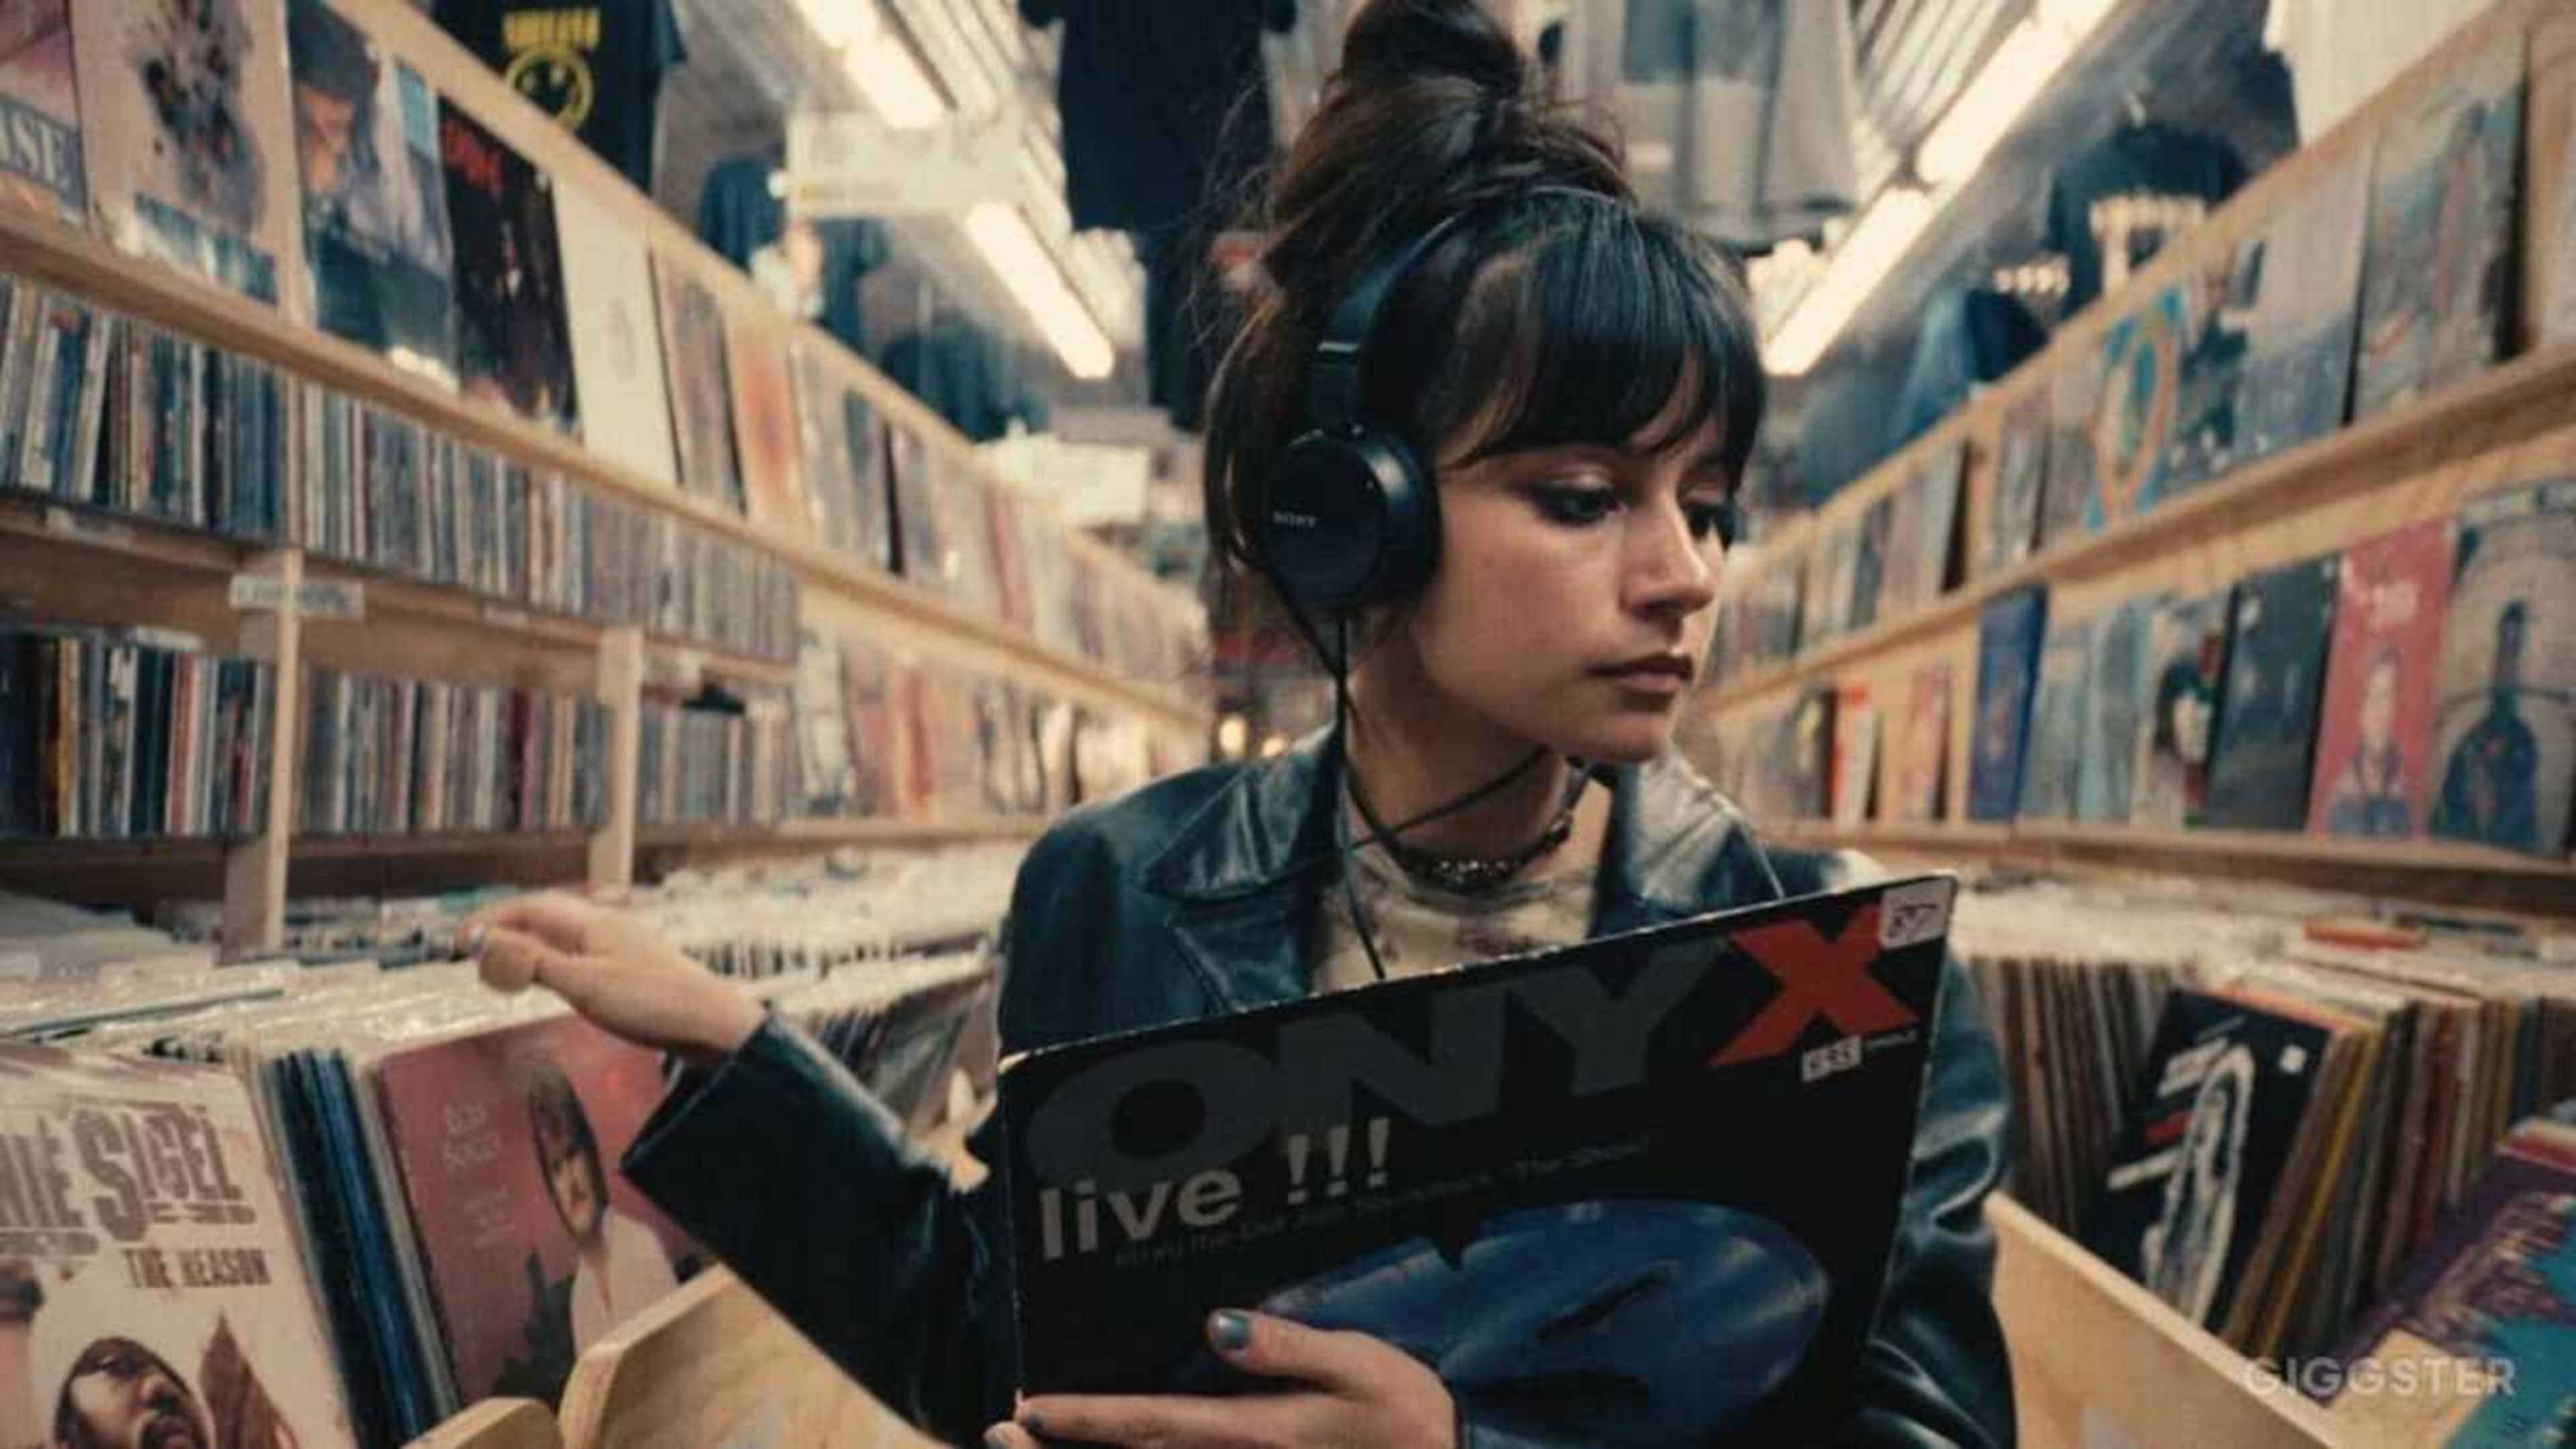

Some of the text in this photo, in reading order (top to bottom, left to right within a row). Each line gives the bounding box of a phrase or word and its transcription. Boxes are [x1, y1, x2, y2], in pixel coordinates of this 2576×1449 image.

[1026, 904, 1920, 1191] ONYX
[1038, 1166, 1244, 1260] live
[1286, 1117, 1391, 1205] !!!
[121, 1248, 272, 1288] THE REASON
